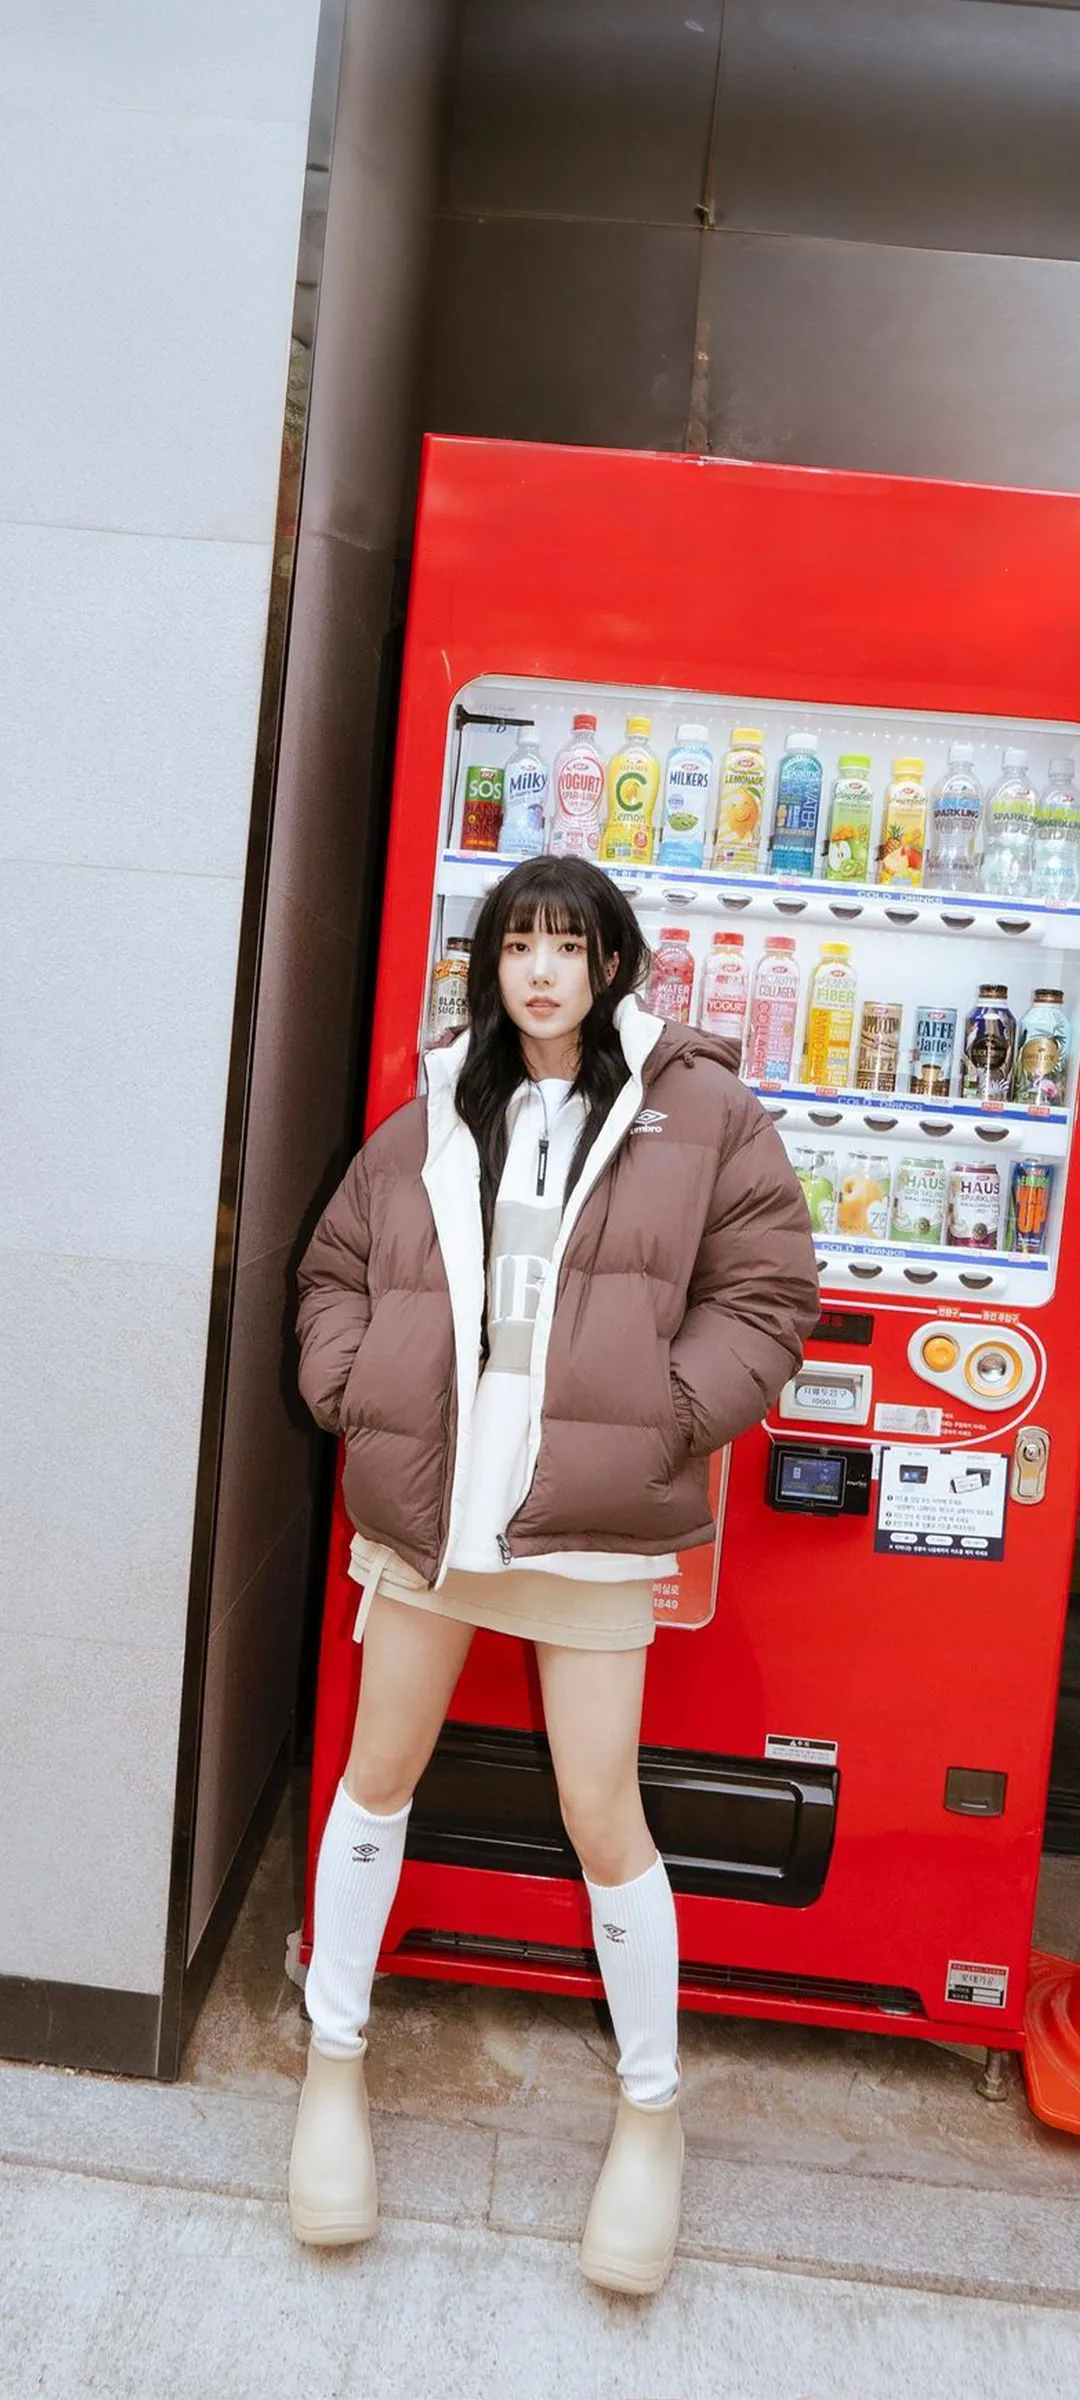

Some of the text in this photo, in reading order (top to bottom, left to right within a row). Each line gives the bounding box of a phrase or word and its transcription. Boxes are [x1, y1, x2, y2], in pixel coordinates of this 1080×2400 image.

[509, 772, 548, 794] Milky
[559, 773, 601, 793] YOGURT
[669, 771, 709, 788] MILKERS
[469, 780, 503, 800] SOS
[616, 772, 648, 812] C
[758, 984, 796, 999] COLLAGEN
[817, 986, 855, 1003] FIBER
[438, 996, 468, 1008] BLACK
[438, 1007, 467, 1016] SUGAR
[917, 1020, 954, 1040] CAFFE
[906, 1175, 946, 1191] HAUS
[961, 1181, 1001, 1195] HAUS
[821, 1242, 855, 1253] COLD
